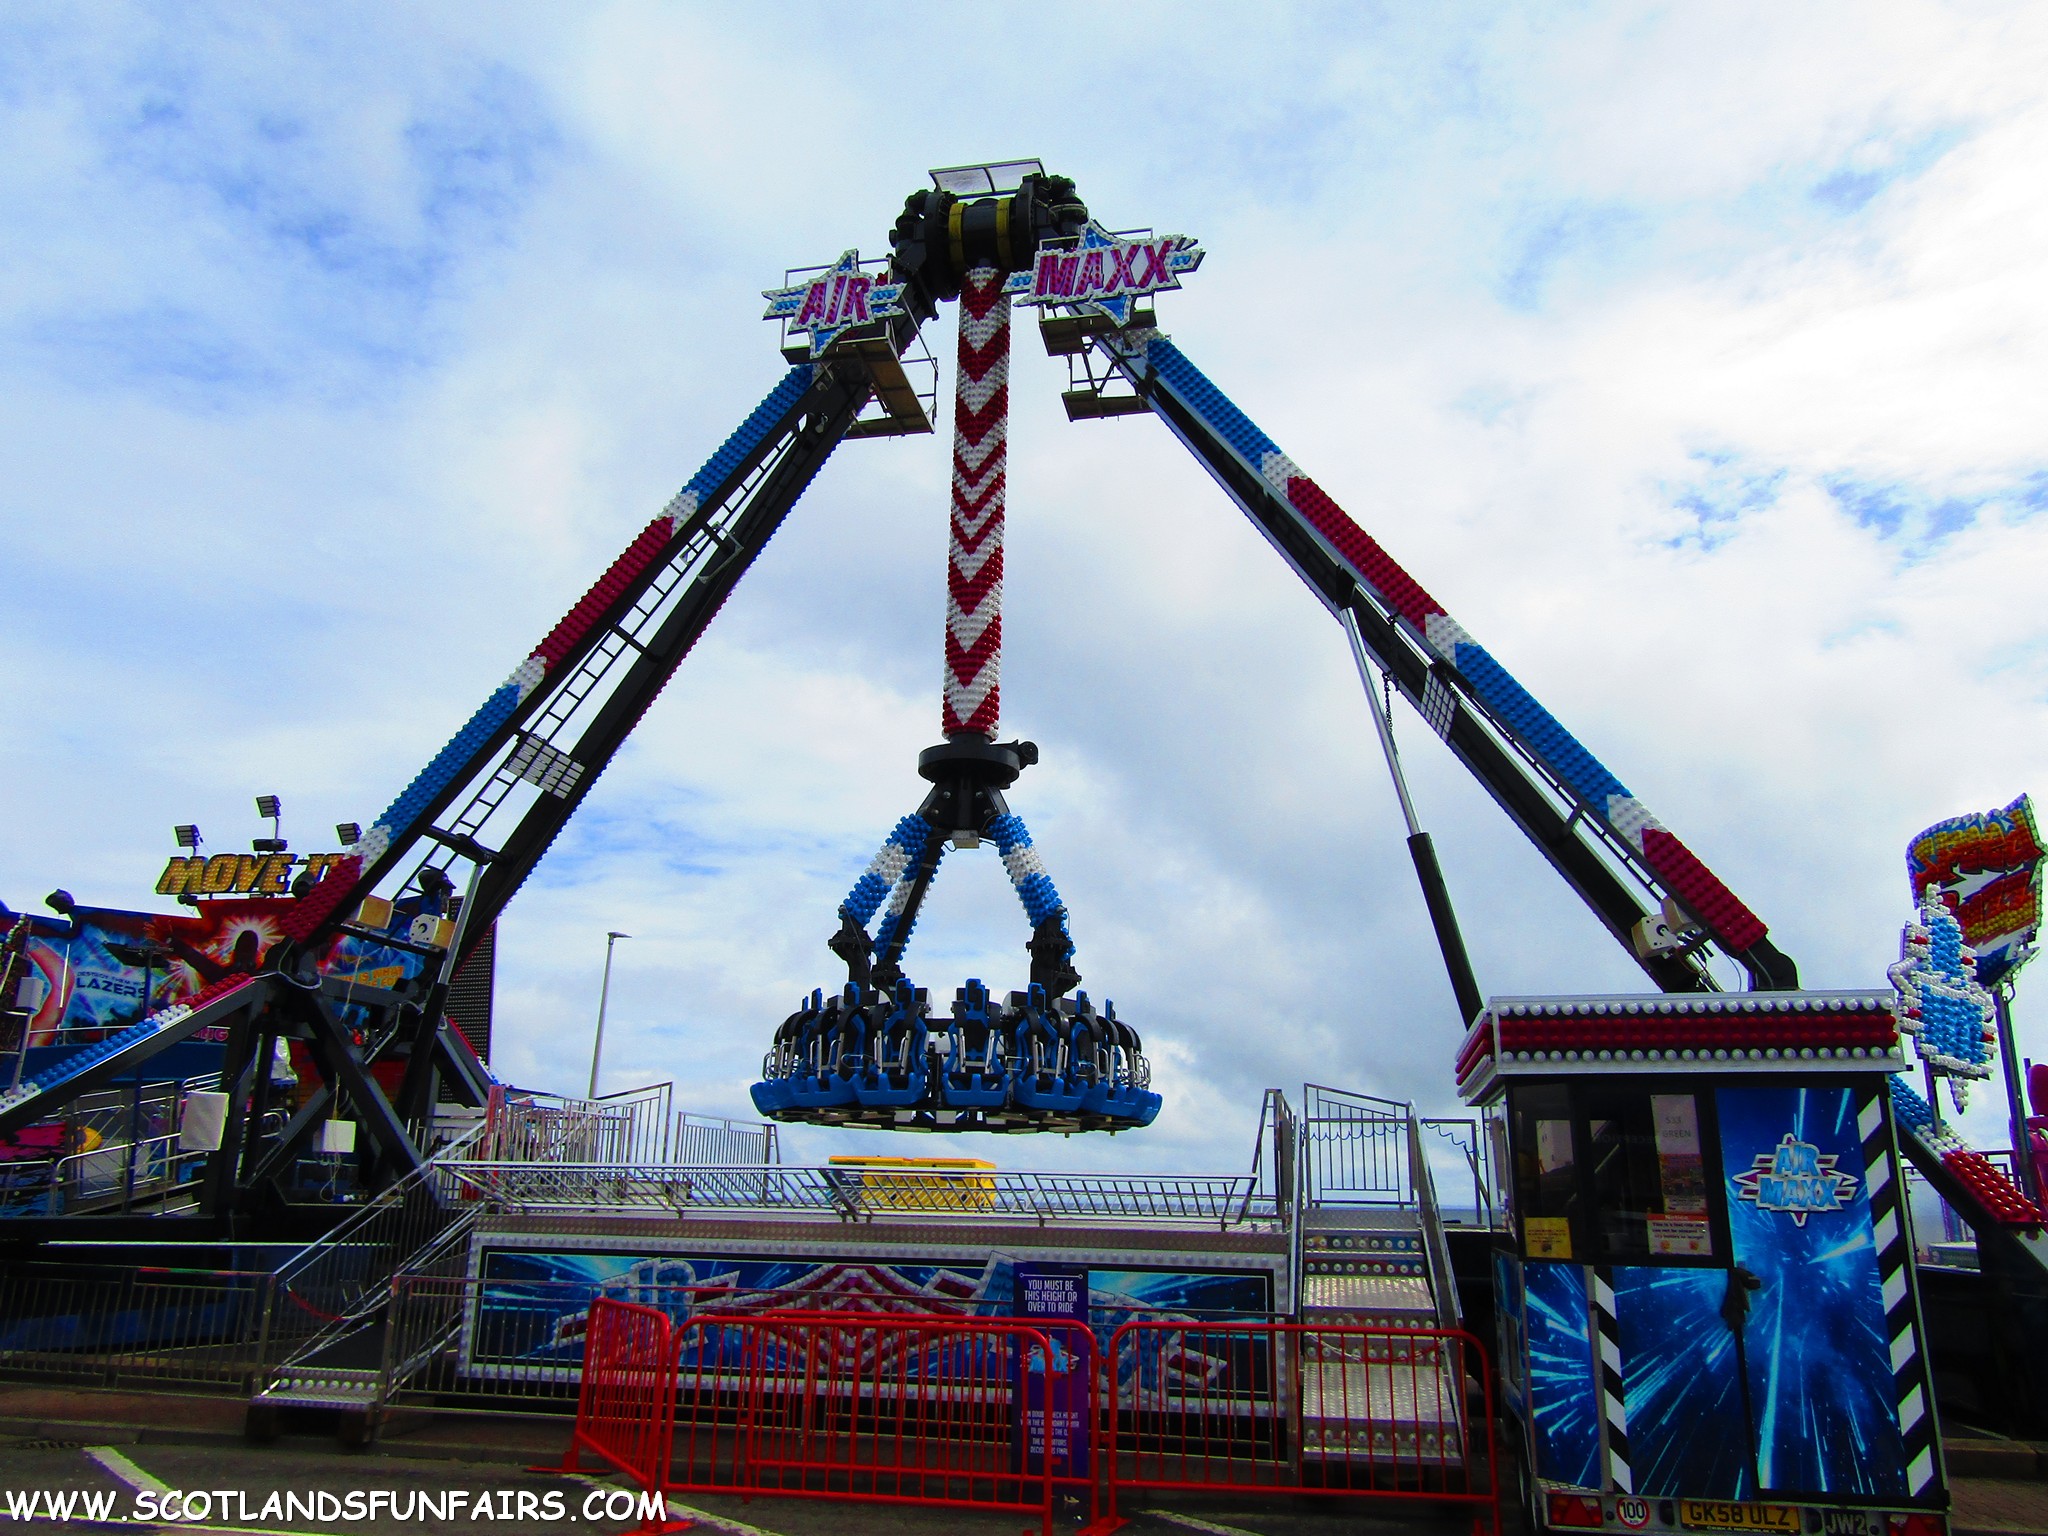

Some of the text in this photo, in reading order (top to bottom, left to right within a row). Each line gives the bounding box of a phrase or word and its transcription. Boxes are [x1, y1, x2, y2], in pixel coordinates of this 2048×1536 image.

[1035, 239, 1174, 297] MAXX
[797, 275, 871, 326] AIR
[157, 853, 297, 895] MOVE
[76, 977, 146, 999] LAZERS
[1775, 1144, 1819, 1177] AIR
[1759, 1177, 1837, 1207] MAXX
[1024, 1290, 1078, 1302] THIS HEIGHT OR
[1028, 1279, 1074, 1291] YOU MUST BE
[1027, 1301, 1074, 1314] OVER TO RIDE
[1621, 1501, 1646, 1519] 100
[1689, 1502, 1791, 1527] GK58 ULZ
